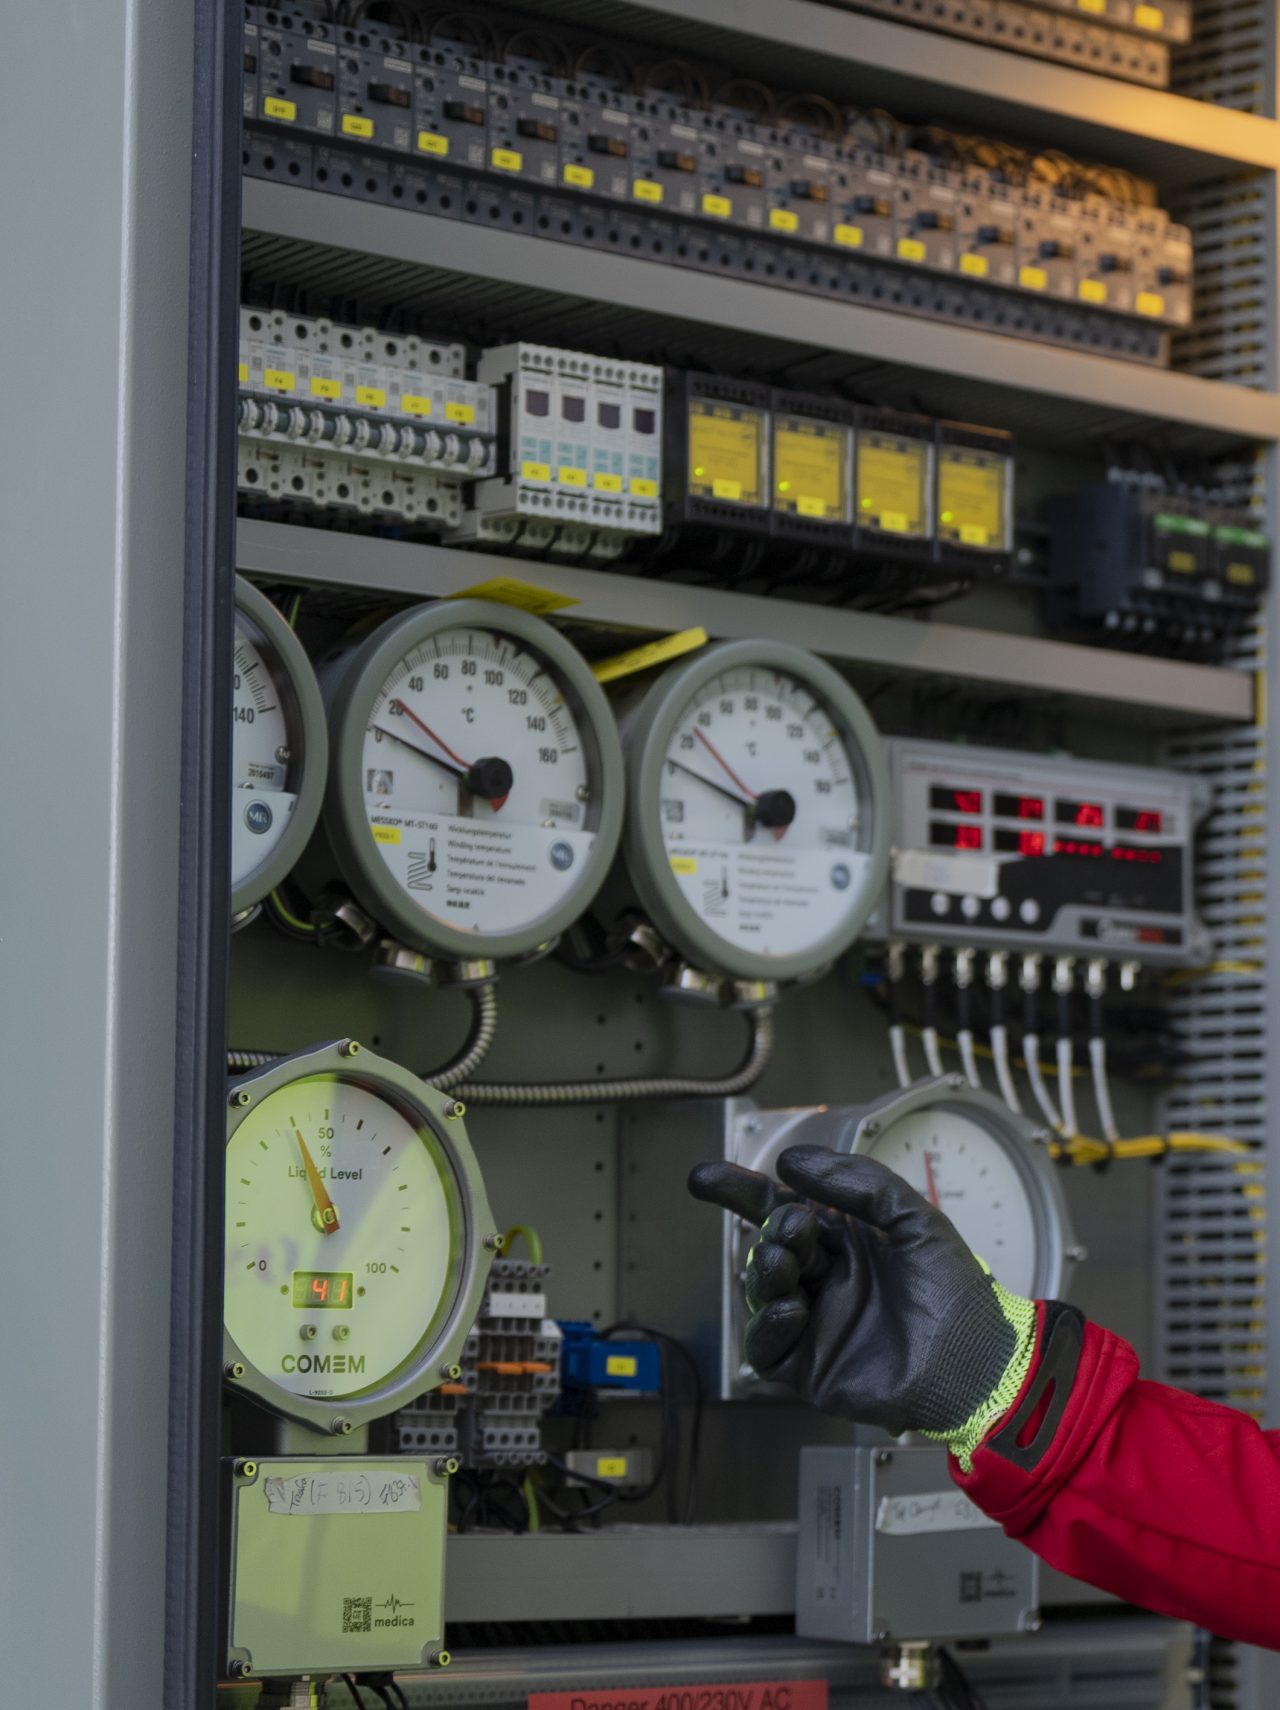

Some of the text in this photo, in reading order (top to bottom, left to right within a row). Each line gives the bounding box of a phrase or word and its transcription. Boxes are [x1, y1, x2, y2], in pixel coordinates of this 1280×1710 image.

[434, 664, 449, 680] 60
[462, 660, 476, 676] 80
[408, 677, 424, 692] 40
[484, 670, 504, 686] 100
[508, 689, 528, 705] 120
[526, 716, 546, 732] 140
[680, 734, 694, 750] 20
[538, 748, 558, 764] 160
[318, 1127, 334, 1140] 50
[320, 1145, 332, 1158] %
[288, 1166, 362, 1181] Liqd Level
[258, 1260, 267, 1272] 0
[365, 1262, 387, 1274] 100
[311, 1278, 348, 1302] 41
[281, 1355, 366, 1374] COMEM
[374, 1616, 415, 1628] medica
[759, 1686, 791, 1710] AC
